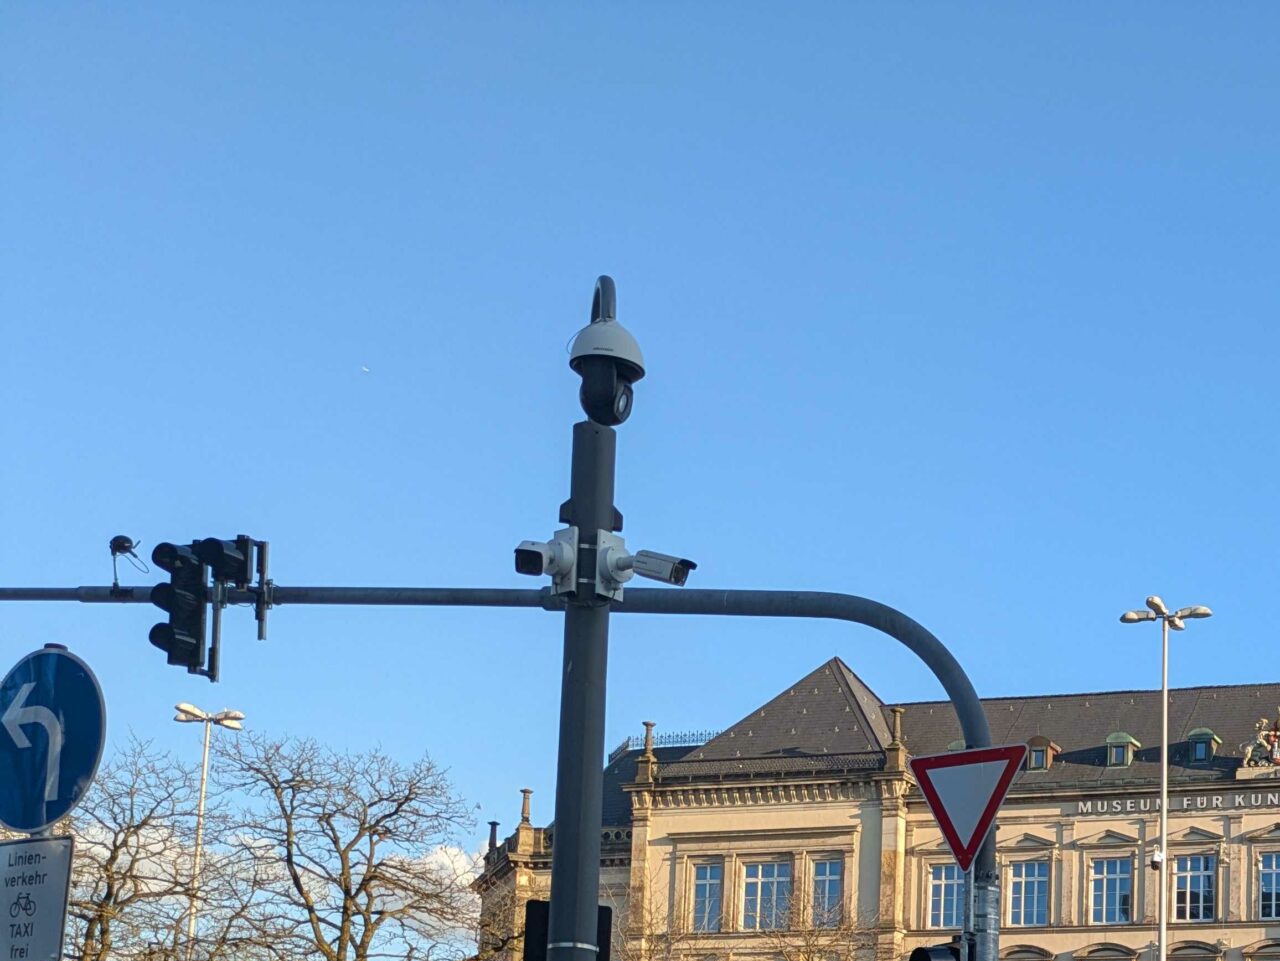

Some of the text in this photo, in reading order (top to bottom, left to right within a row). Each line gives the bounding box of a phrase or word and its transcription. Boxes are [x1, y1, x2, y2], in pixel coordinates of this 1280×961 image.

[1183, 795, 1223, 809] FÜR
[8, 852, 47, 867] Linien-
[4, 871, 48, 888] verkehr
[9, 922, 34, 938] TAXI
[10, 943, 29, 959] frei
